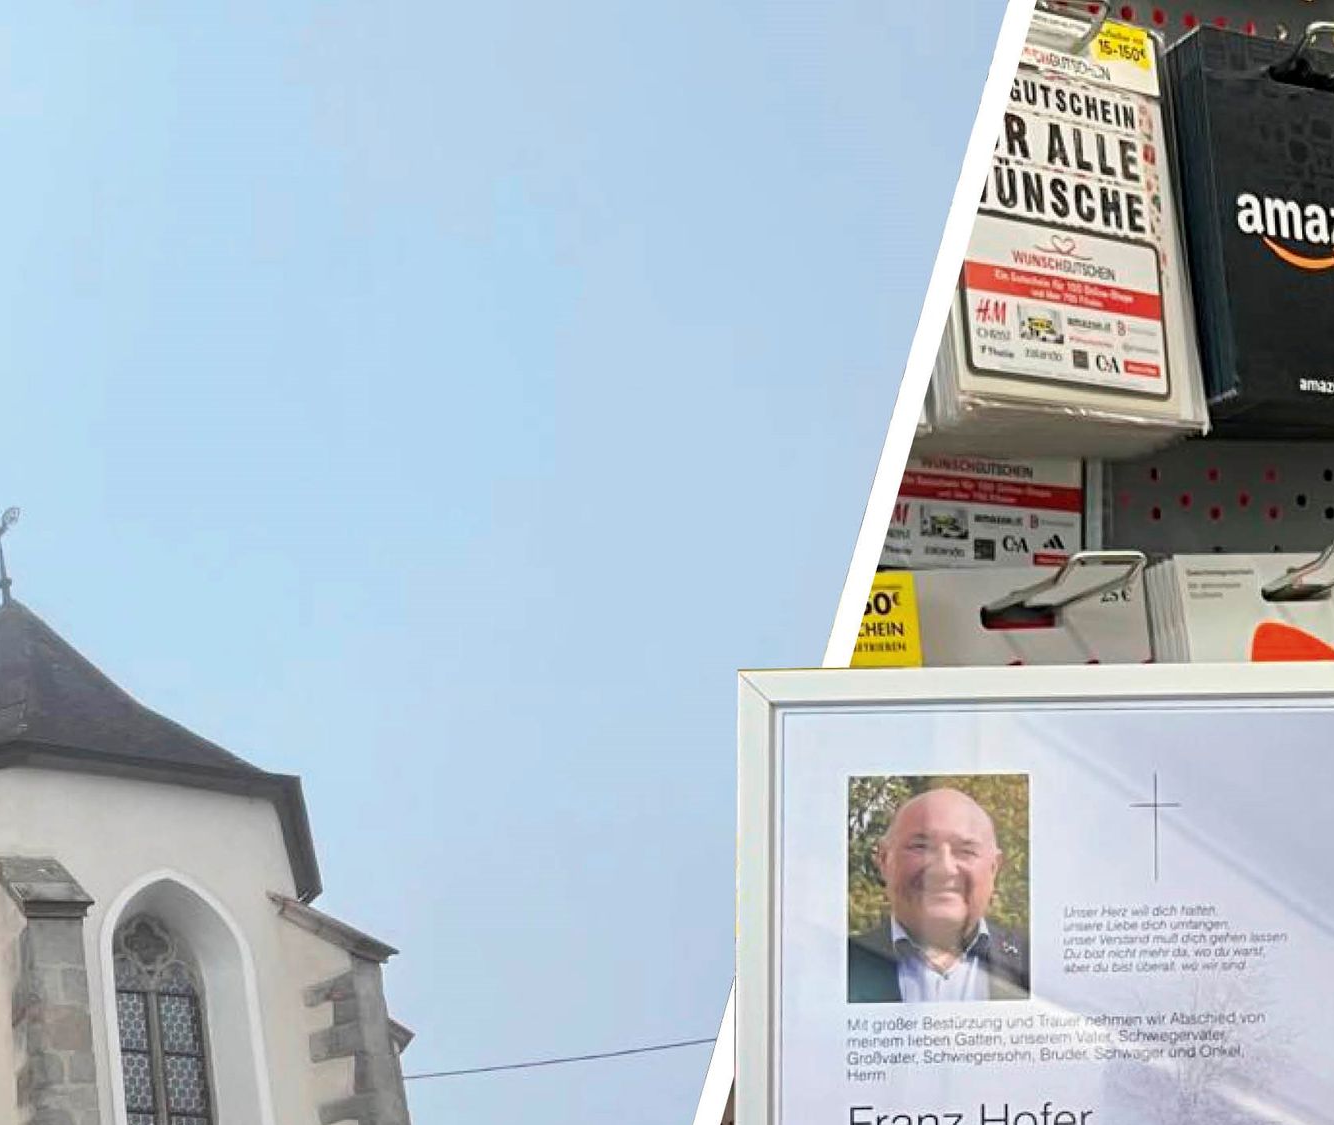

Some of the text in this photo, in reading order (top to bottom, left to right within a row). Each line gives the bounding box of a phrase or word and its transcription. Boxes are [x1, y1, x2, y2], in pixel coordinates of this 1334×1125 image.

[1011, 79, 1135, 129] GUTSCHEIN
[995, 113, 1139, 181] R ALLE
[923, 1015, 1001, 1030] Bestürzung
[1007, 1015, 1033, 1028] und
[1086, 1015, 1141, 1025] nehmen
[1147, 1013, 1165, 1024] wir
[1171, 1012, 1235, 1024] Abschied
[1240, 1013, 1265, 1023] von
[847, 1036, 903, 1047] meinem
[909, 1034, 950, 1045] lieben
[1168, 1046, 1196, 1058] und
